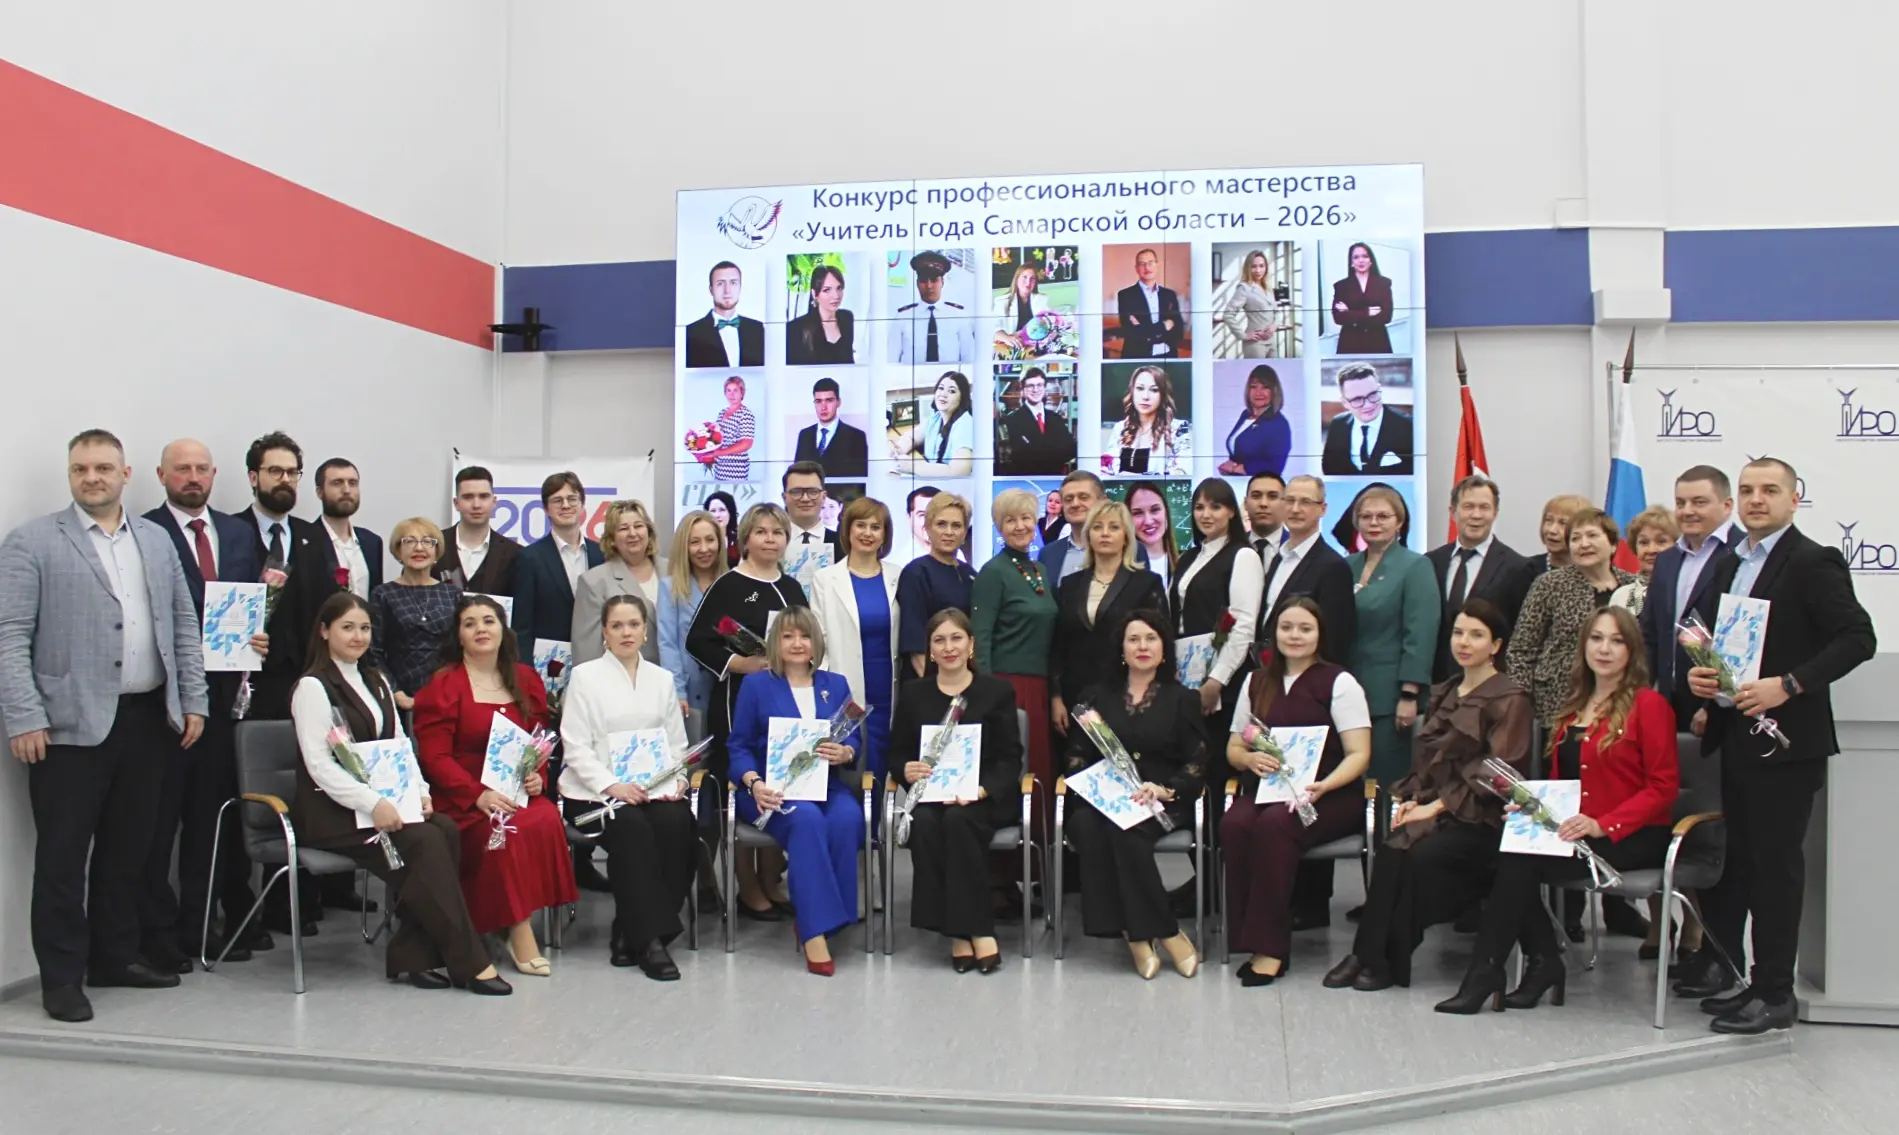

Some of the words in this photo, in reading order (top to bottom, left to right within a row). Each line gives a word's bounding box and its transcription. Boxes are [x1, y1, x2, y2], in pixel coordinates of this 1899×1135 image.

[812, 187, 918, 212] Конкурс
[927, 180, 1196, 208] профессионального
[1206, 174, 1357, 198] мастерства
[792, 221, 909, 242] «Учитель
[919, 219, 975, 241] года
[983, 209, 1129, 239] Самарской
[1137, 208, 1246, 231] области
[1277, 204, 1357, 227] 2026»
